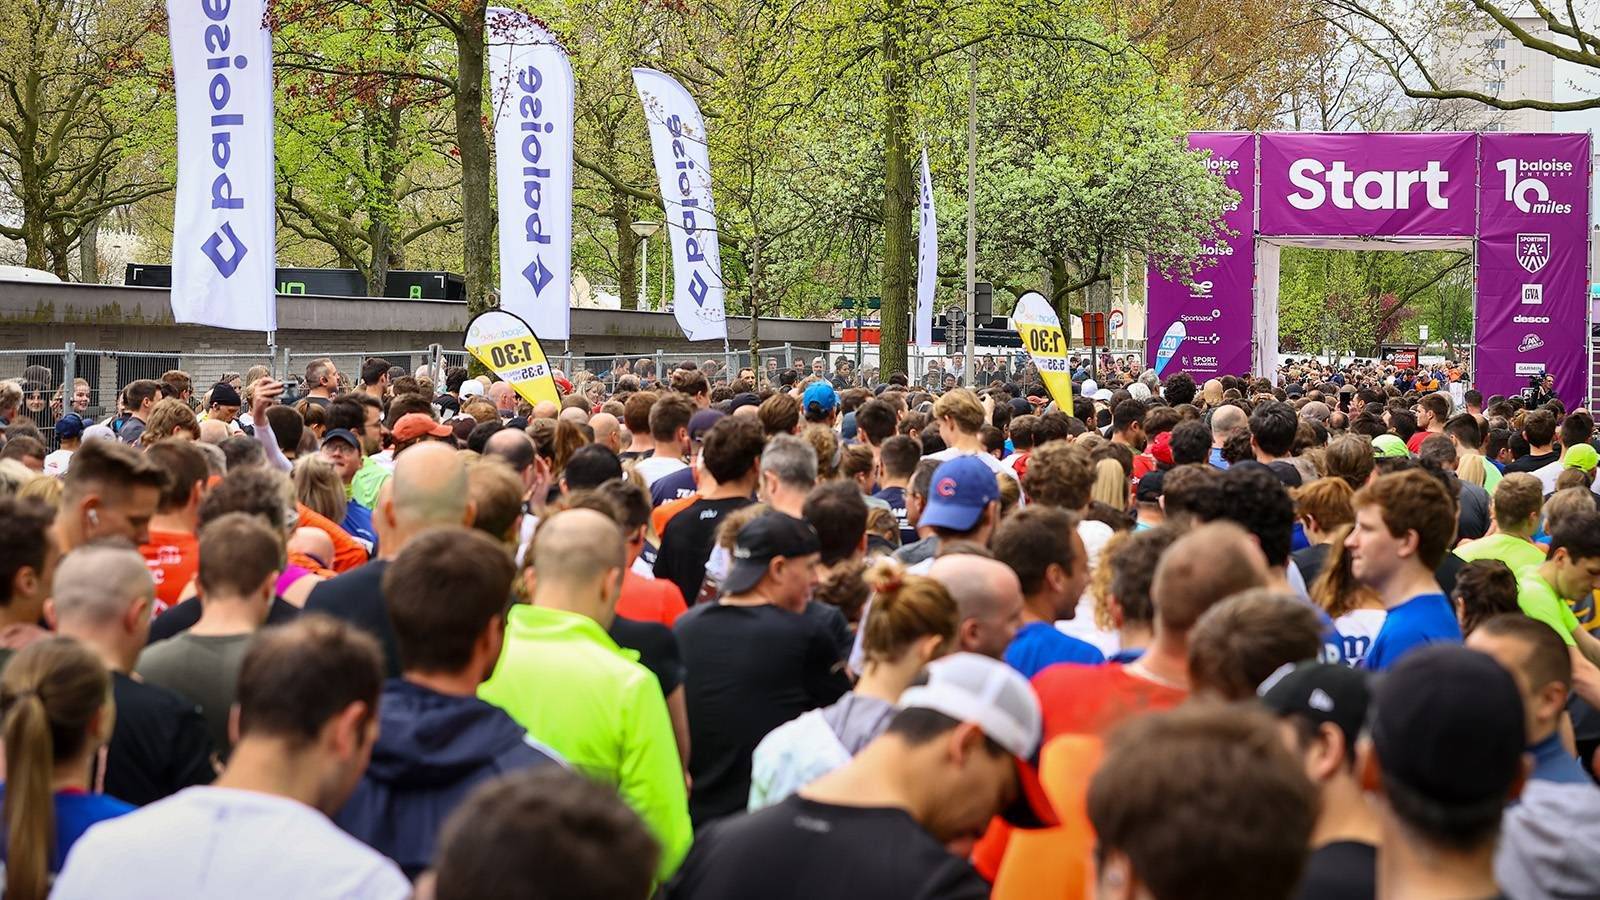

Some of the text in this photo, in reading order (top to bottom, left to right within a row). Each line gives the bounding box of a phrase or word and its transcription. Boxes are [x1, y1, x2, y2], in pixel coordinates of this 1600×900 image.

[1199, 157, 1239, 170] aloise
[1519, 158, 1573, 171] baloise
[1286, 158, 1449, 211] Start
[1496, 158, 1550, 213] 10
[1532, 200, 1572, 214] miles
[1525, 288, 1539, 300] GVA
[1513, 314, 1550, 323] desco
